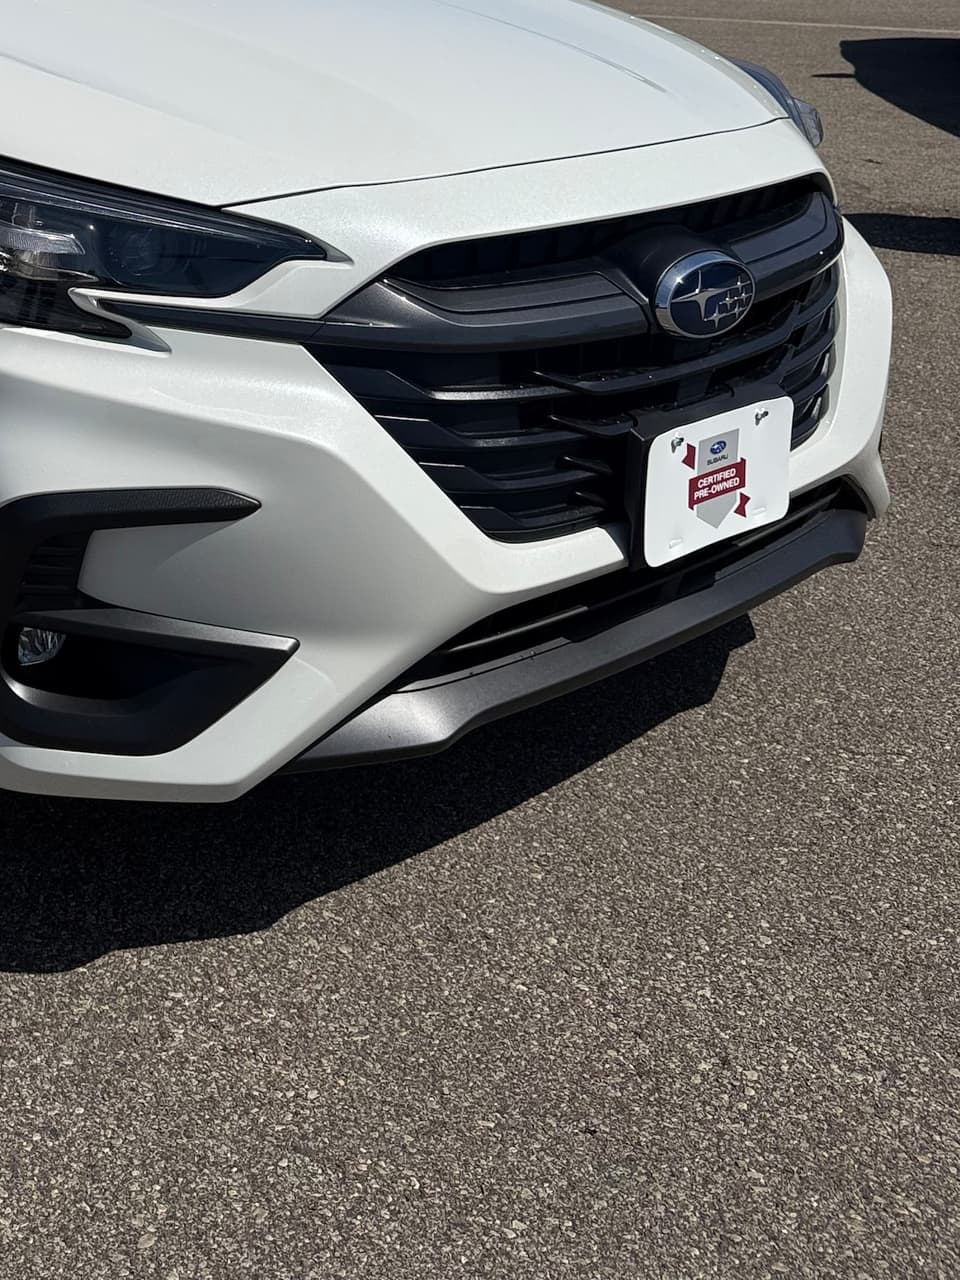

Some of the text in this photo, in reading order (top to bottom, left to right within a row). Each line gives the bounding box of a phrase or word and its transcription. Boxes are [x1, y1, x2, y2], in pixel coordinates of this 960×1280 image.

[707, 454, 728, 465] SUBARU
[697, 468, 736, 488] CERTIFIED
[694, 477, 740, 500] PRE-OWNED
